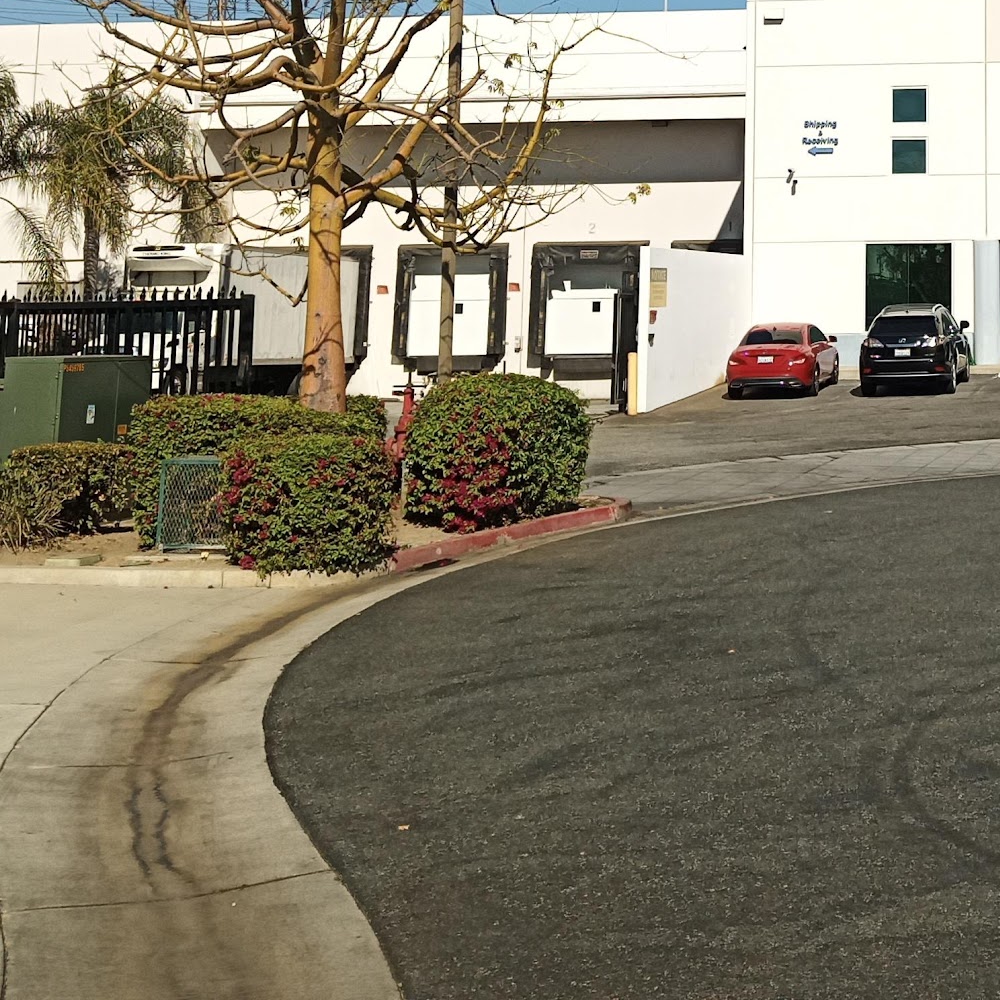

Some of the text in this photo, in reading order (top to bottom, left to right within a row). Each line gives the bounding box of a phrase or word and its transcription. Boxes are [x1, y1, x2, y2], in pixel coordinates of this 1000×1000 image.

[804, 120, 837, 129] Shipping
[802, 137, 838, 146] Receiving
[588, 223, 596, 234] 2
